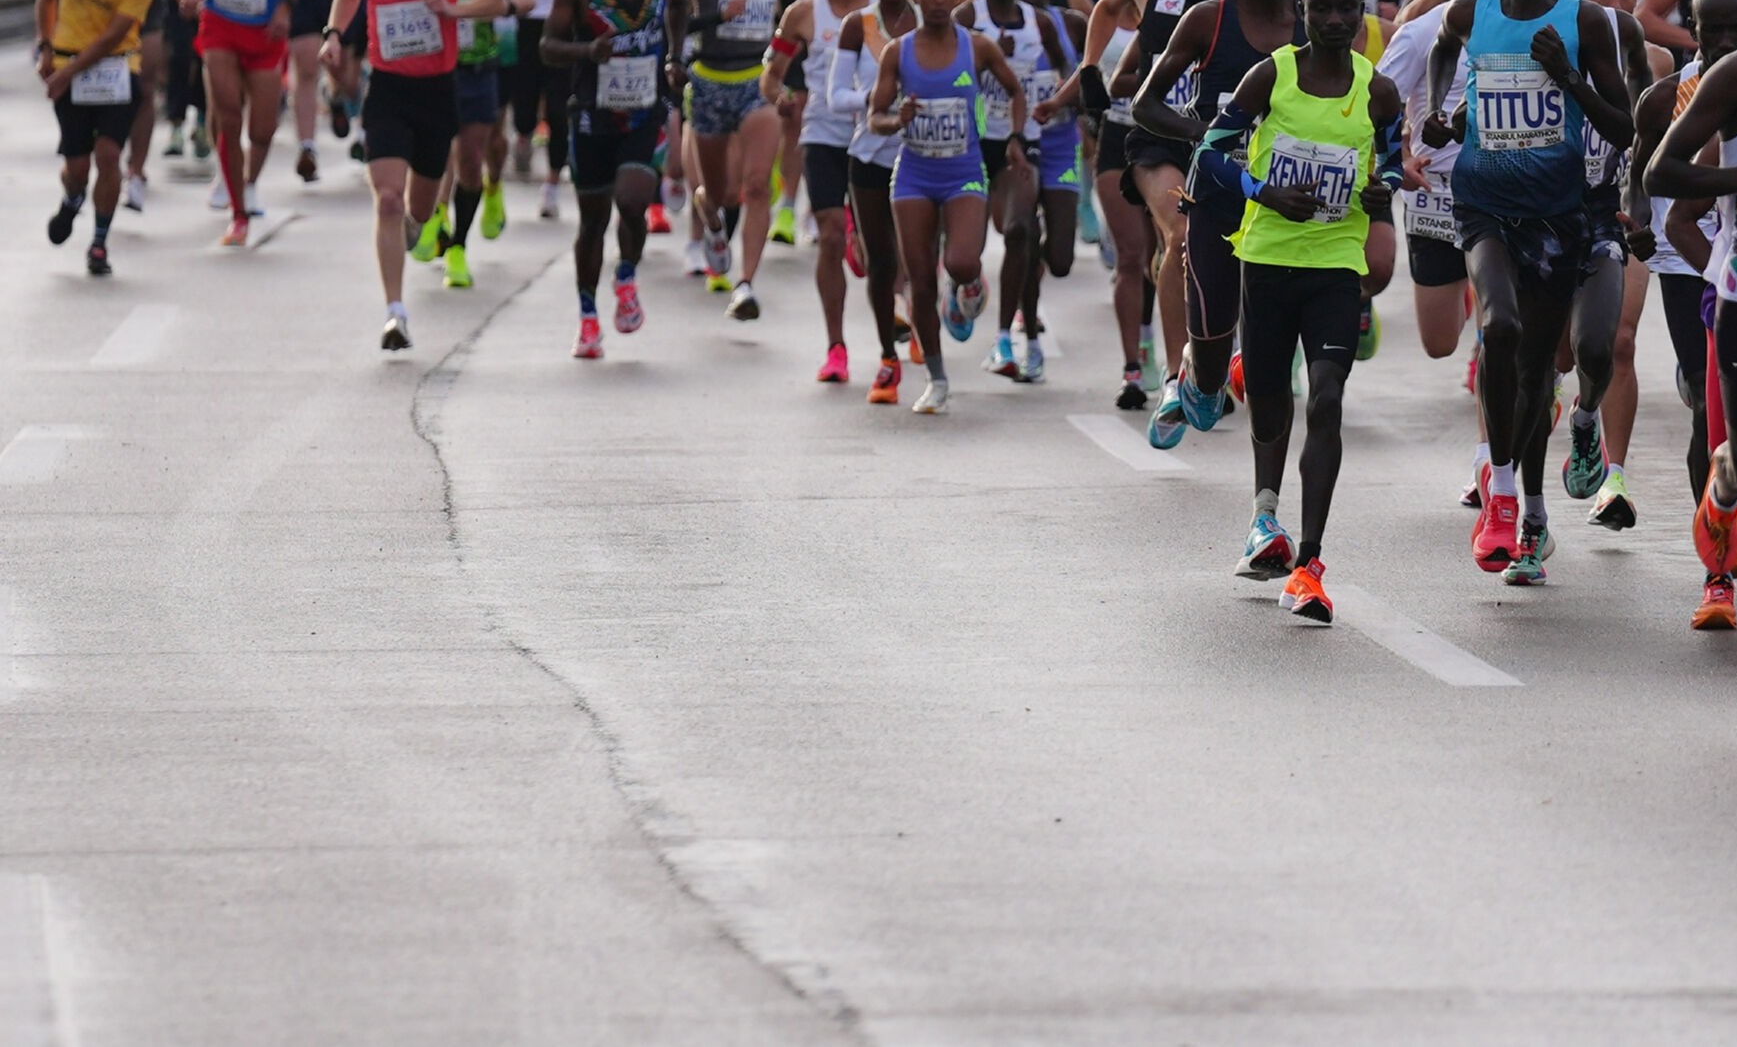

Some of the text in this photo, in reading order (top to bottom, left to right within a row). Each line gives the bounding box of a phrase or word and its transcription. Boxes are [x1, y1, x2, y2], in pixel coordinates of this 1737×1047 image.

[1479, 89, 1563, 129] TITUS
[1485, 130, 1559, 141] ISTANBUL MARATHON
[1545, 137, 1562, 146] 2024
[1268, 152, 1356, 205] KENNETH
[1416, 193, 1454, 213] B 15
[1417, 217, 1457, 231] ISTANBU
